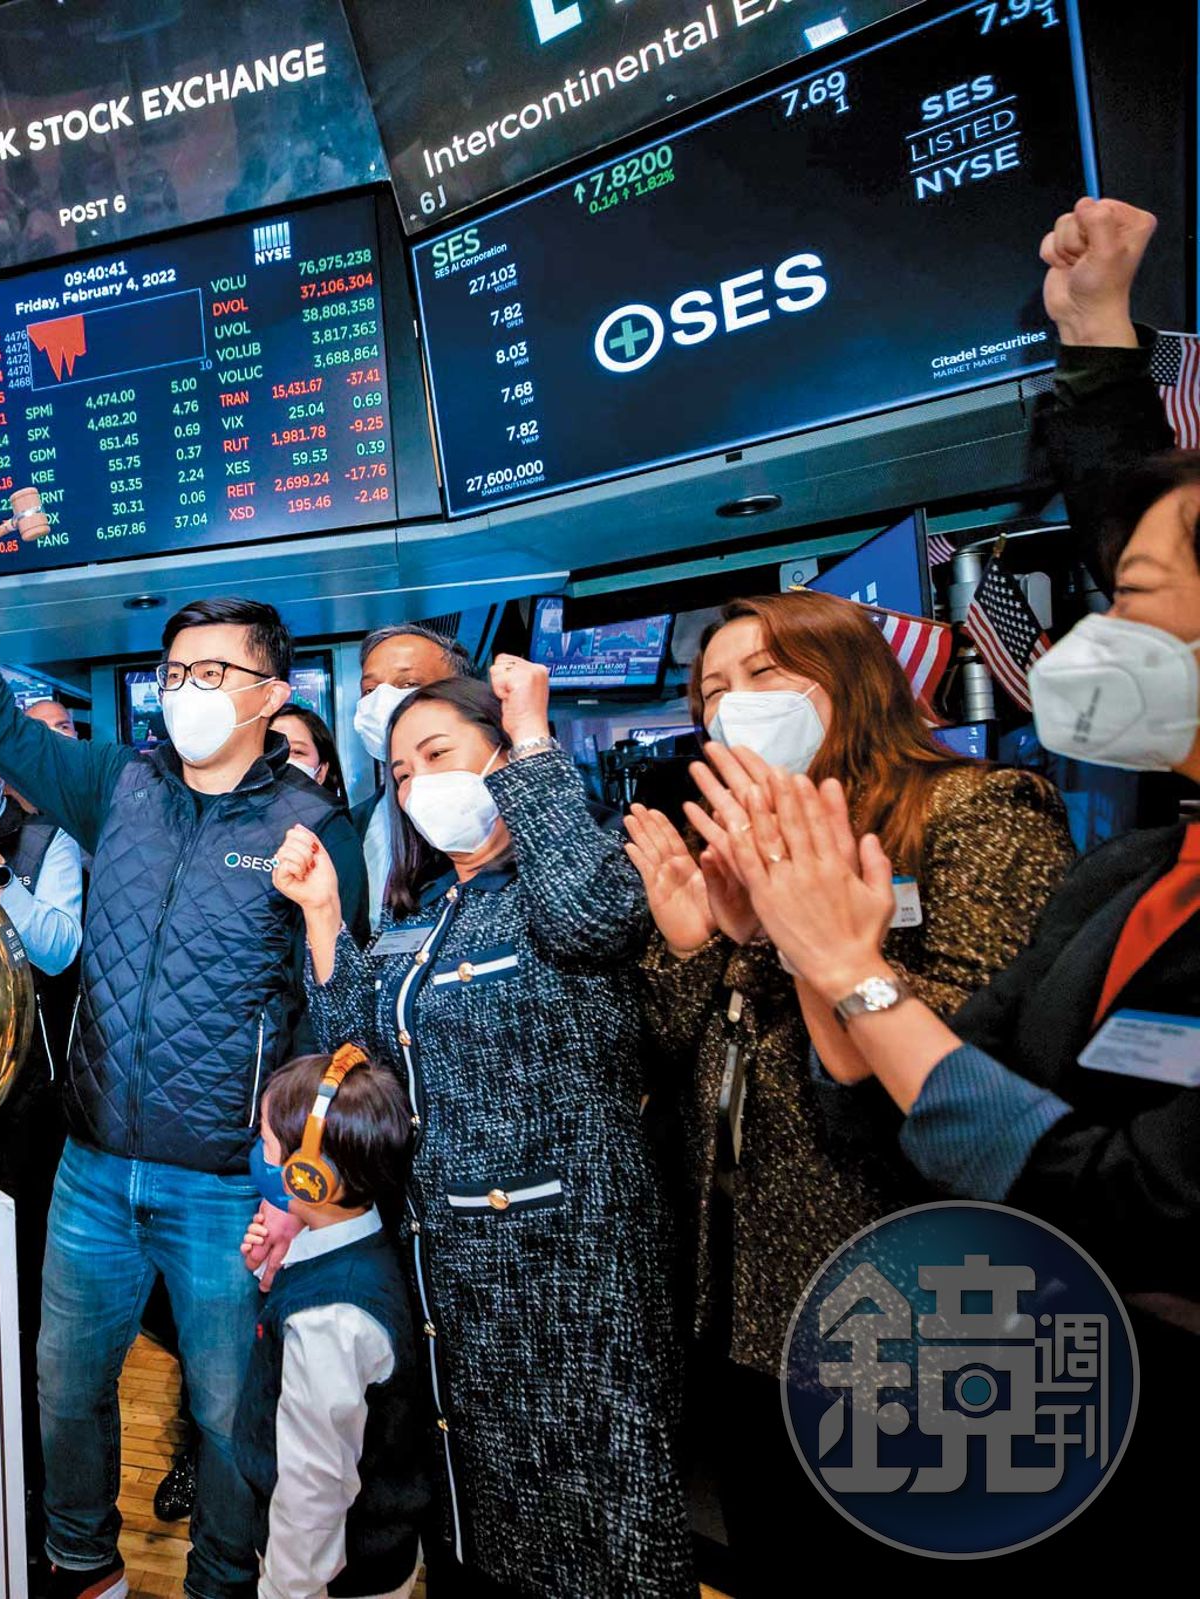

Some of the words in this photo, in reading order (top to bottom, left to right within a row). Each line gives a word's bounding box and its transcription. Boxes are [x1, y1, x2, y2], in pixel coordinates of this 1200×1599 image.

[1042, 8, 1060, 29] 1
[28, 95, 134, 151] STOCK
[141, 41, 327, 121] EXCHANGE
[423, 4, 719, 178] Intercontinental
[780, 71, 846, 117] 7.69
[835, 95, 850, 114] 1
[921, 74, 996, 120] SES
[910, 110, 1016, 163] LISTED
[589, 145, 673, 198] 7.8200
[915, 142, 1020, 199] NYSE
[59, 202, 108, 227] POST
[113, 195, 128, 214] 6
[420, 184, 447, 215] 6J
[588, 194, 619, 215] 0.14
[634, 171, 675, 197] 1.82%
[255, 246, 291, 265] NYSE
[432, 228, 480, 268] SES
[460, 243, 507, 268] Corporation
[64, 260, 128, 287] 09:40:41
[211, 274, 247, 293] VOLU
[299, 249, 372, 276] 76,975,238
[469, 263, 517, 295] 27,103
[15, 297, 59, 315] Friday,
[62, 282, 122, 305] February
[126, 277, 139, 291] 4,
[143, 268, 176, 288] 2022
[213, 298, 249, 317] DVOL
[300, 272, 374, 300] 37,106,304
[670, 252, 827, 346] SES
[215, 321, 251, 339] UVOL
[302, 297, 375, 323] 38,808,358
[490, 303, 522, 326] 7.82
[5, 342, 28, 355] 4474
[216, 342, 261, 362] VOLUB
[312, 321, 377, 345] 3,817,363
[496, 341, 527, 364] 8.03
[930, 346, 977, 369] Citadel
[979, 330, 1048, 357] Securities
[6, 354, 29, 367] 4472
[7, 365, 30, 378] 4470
[218, 365, 263, 385] VOLUC
[314, 345, 378, 368] 3,688,864
[932, 361, 972, 380] MARKET
[973, 354, 1008, 373] MAKER
[8, 377, 31, 390] 4468
[25, 403, 53, 420] SPMI
[85, 389, 135, 409] 4,474.00
[171, 378, 197, 394] 5.00
[220, 392, 249, 407] TRAN
[272, 378, 322, 399] 15,431.67
[346, 368, 381, 385] -37.41
[501, 381, 533, 403] 7.68
[27, 427, 50, 442] SPX
[87, 411, 137, 431] 4,482.20
[172, 400, 199, 416] 4.76
[221, 415, 244, 430] VIX
[288, 402, 324, 420] 25.04
[353, 392, 382, 408] 0.69
[29, 447, 56, 463] GDM
[100, 433, 139, 451] 851.45
[174, 422, 200, 438] 0.69
[223, 437, 250, 452] RUT
[271, 425, 326, 446] 1,981.78
[349, 416, 384, 432] -9.25
[506, 420, 538, 441] 7.82
[31, 469, 55, 485] KBE
[108, 455, 141, 472] 55.75
[176, 445, 202, 461] 0.37
[226, 460, 250, 476] XES
[292, 449, 328, 465] 59.53
[356, 440, 385, 456] 0.39
[40, 489, 64, 504] RNT
[110, 478, 143, 494] 93.35
[178, 468, 204, 483] 2.24
[227, 482, 256, 499] REIT
[274, 472, 330, 492] 2,699.24
[344, 464, 387, 481] -17.76
[466, 460, 544, 493] 27,600,000
[112, 500, 145, 516] 30.31
[180, 491, 206, 505] 0.06
[229, 506, 255, 521] XSD
[288, 495, 331, 513] 195.46
[354, 487, 389, 503] -2.48
[37, 532, 69, 548] FANG
[96, 522, 146, 541] 6,567.86
[174, 513, 208, 529] 37.04
[241, 855, 273, 872] SES
